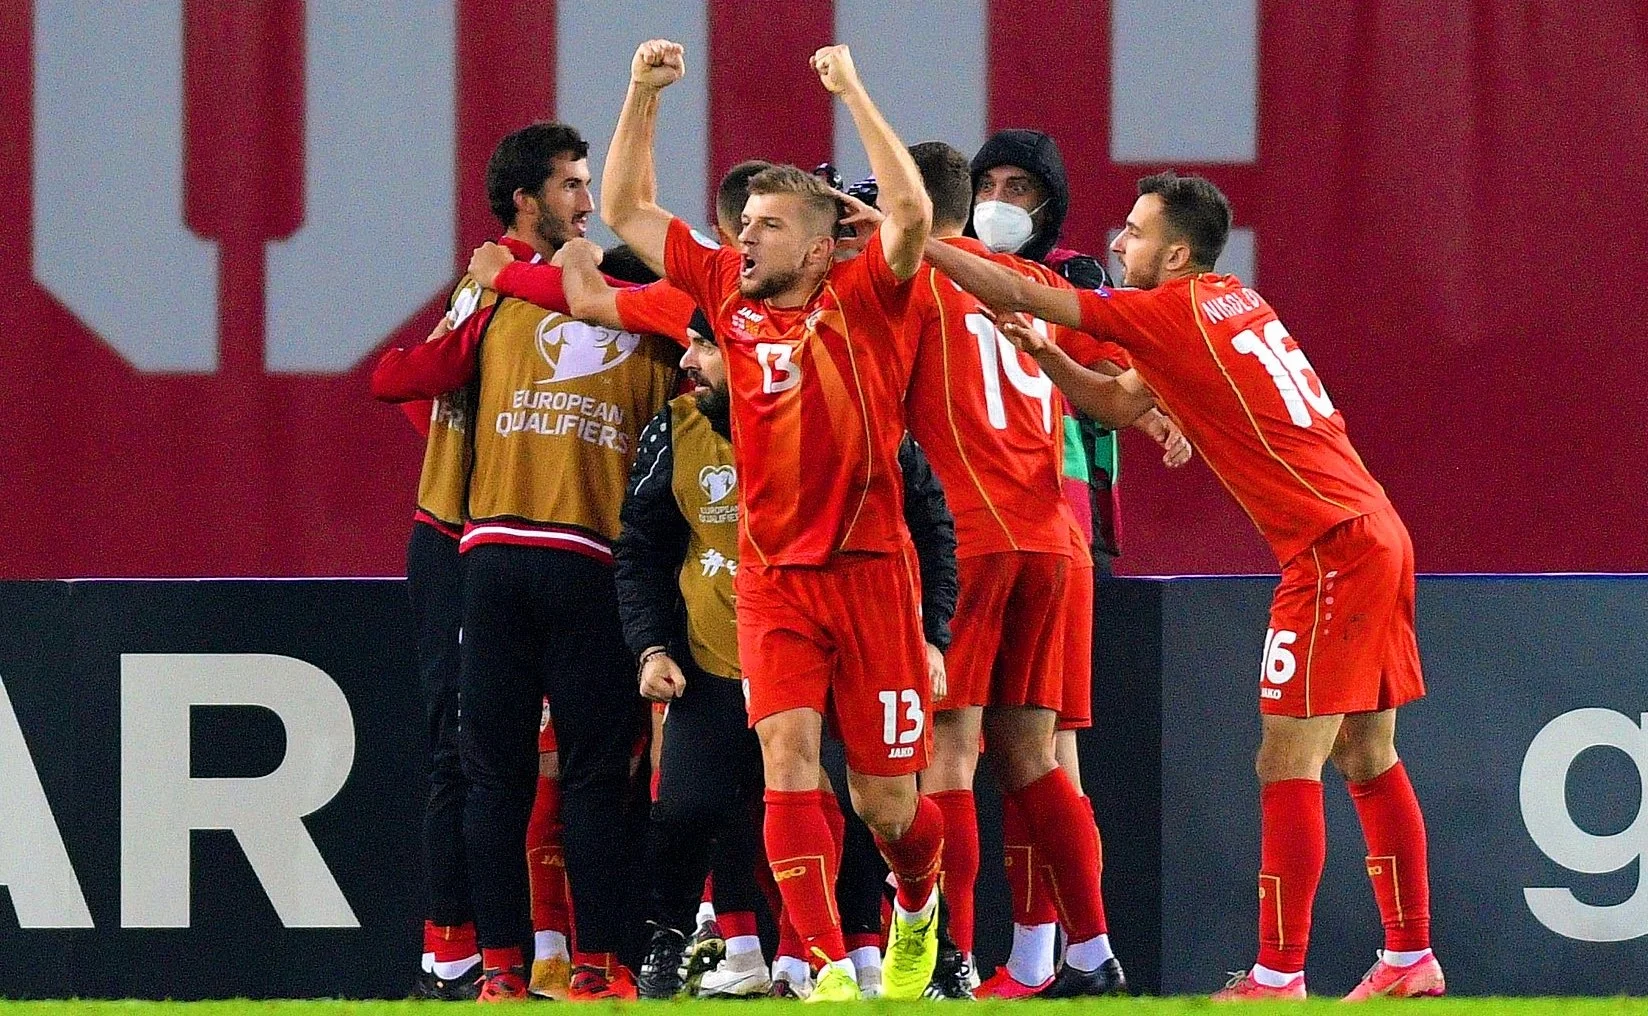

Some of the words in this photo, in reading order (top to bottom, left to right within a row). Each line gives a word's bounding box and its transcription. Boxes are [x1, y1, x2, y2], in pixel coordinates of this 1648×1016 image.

[1201, 287, 1269, 325] NIKOLO
[755, 343, 800, 394] 13
[965, 313, 1053, 434] 14
[1231, 319, 1335, 428] 16
[496, 411, 630, 454] QUALIFIERS
[513, 389, 622, 425] EUROPEAN
[879, 689, 924, 745] 13
[888, 747, 914, 758] JAKO
[1519, 707, 1648, 942] g
